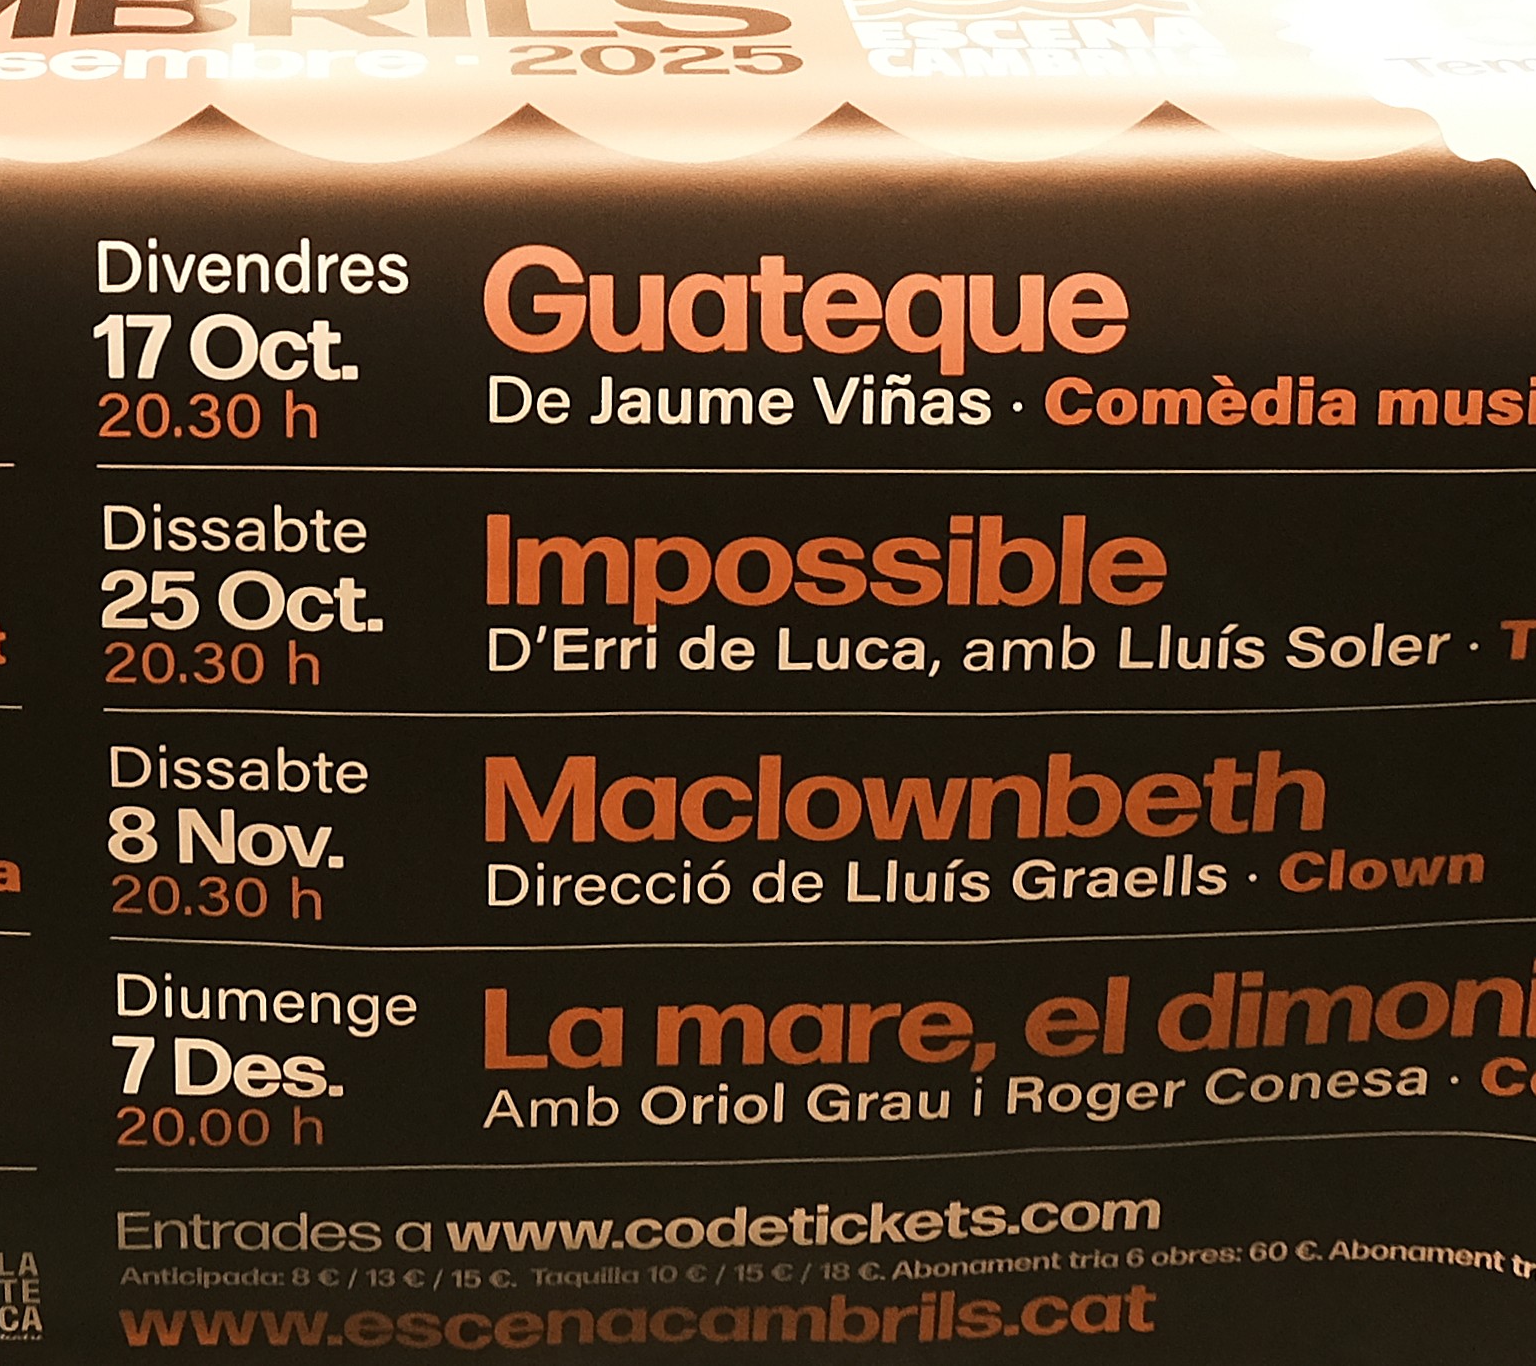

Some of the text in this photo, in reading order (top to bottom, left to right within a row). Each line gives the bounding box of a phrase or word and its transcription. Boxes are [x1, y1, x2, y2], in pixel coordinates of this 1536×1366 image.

[508, 42, 805, 77] 2025
[94, 234, 411, 297] Divendres
[482, 243, 1131, 377] Guateque
[90, 311, 361, 385] 17 Oct.
[95, 389, 320, 441] 20.30 h
[487, 374, 572, 426] De
[588, 374, 795, 428] Jaume
[811, 373, 994, 428] Viñas
[1041, 372, 1358, 429] Comèdia
[100, 501, 370, 556] Dissabte
[484, 512, 1169, 628] Impossible
[99, 568, 386, 635] 25 Oct.
[103, 639, 323, 688] 20.30 h
[485, 620, 1454, 680] D'Erri de Luca, amb Lluís Soler
[107, 743, 371, 795] Dissabte
[484, 749, 1328, 845] Maclownbeth
[106, 806, 347, 871] 8 Nov.
[109, 873, 324, 922] 20.30 h
[485, 851, 1230, 909] Direcció de Lluís Graells
[1276, 848, 1488, 897] Clown
[114, 970, 419, 1038] Diumenge
[483, 986, 627, 1072] La
[654, 999, 1000, 1074] mare,
[1021, 974, 1132, 1059] el
[110, 1035, 347, 1100] 7 Des.
[482, 1063, 1431, 1130] Amb Oriol Grau i Roger Conesa
[115, 1104, 326, 1149] 20.00 h
[115, 1196, 1163, 1255] Entrades a www.codetickets.com
[534, 1265, 640, 1289] Taquilla
[890, 1251, 1062, 1282] Abonament
[1068, 1248, 1120, 1271] tria
[1125, 1247, 1146, 1269] 6
[1150, 1244, 1244, 1268] obres:
[1248, 1239, 1290, 1264] 60
[1328, 1238, 1508, 1274] Abonament
[117, 1283, 1159, 1351] www.escenacambrils.cat
